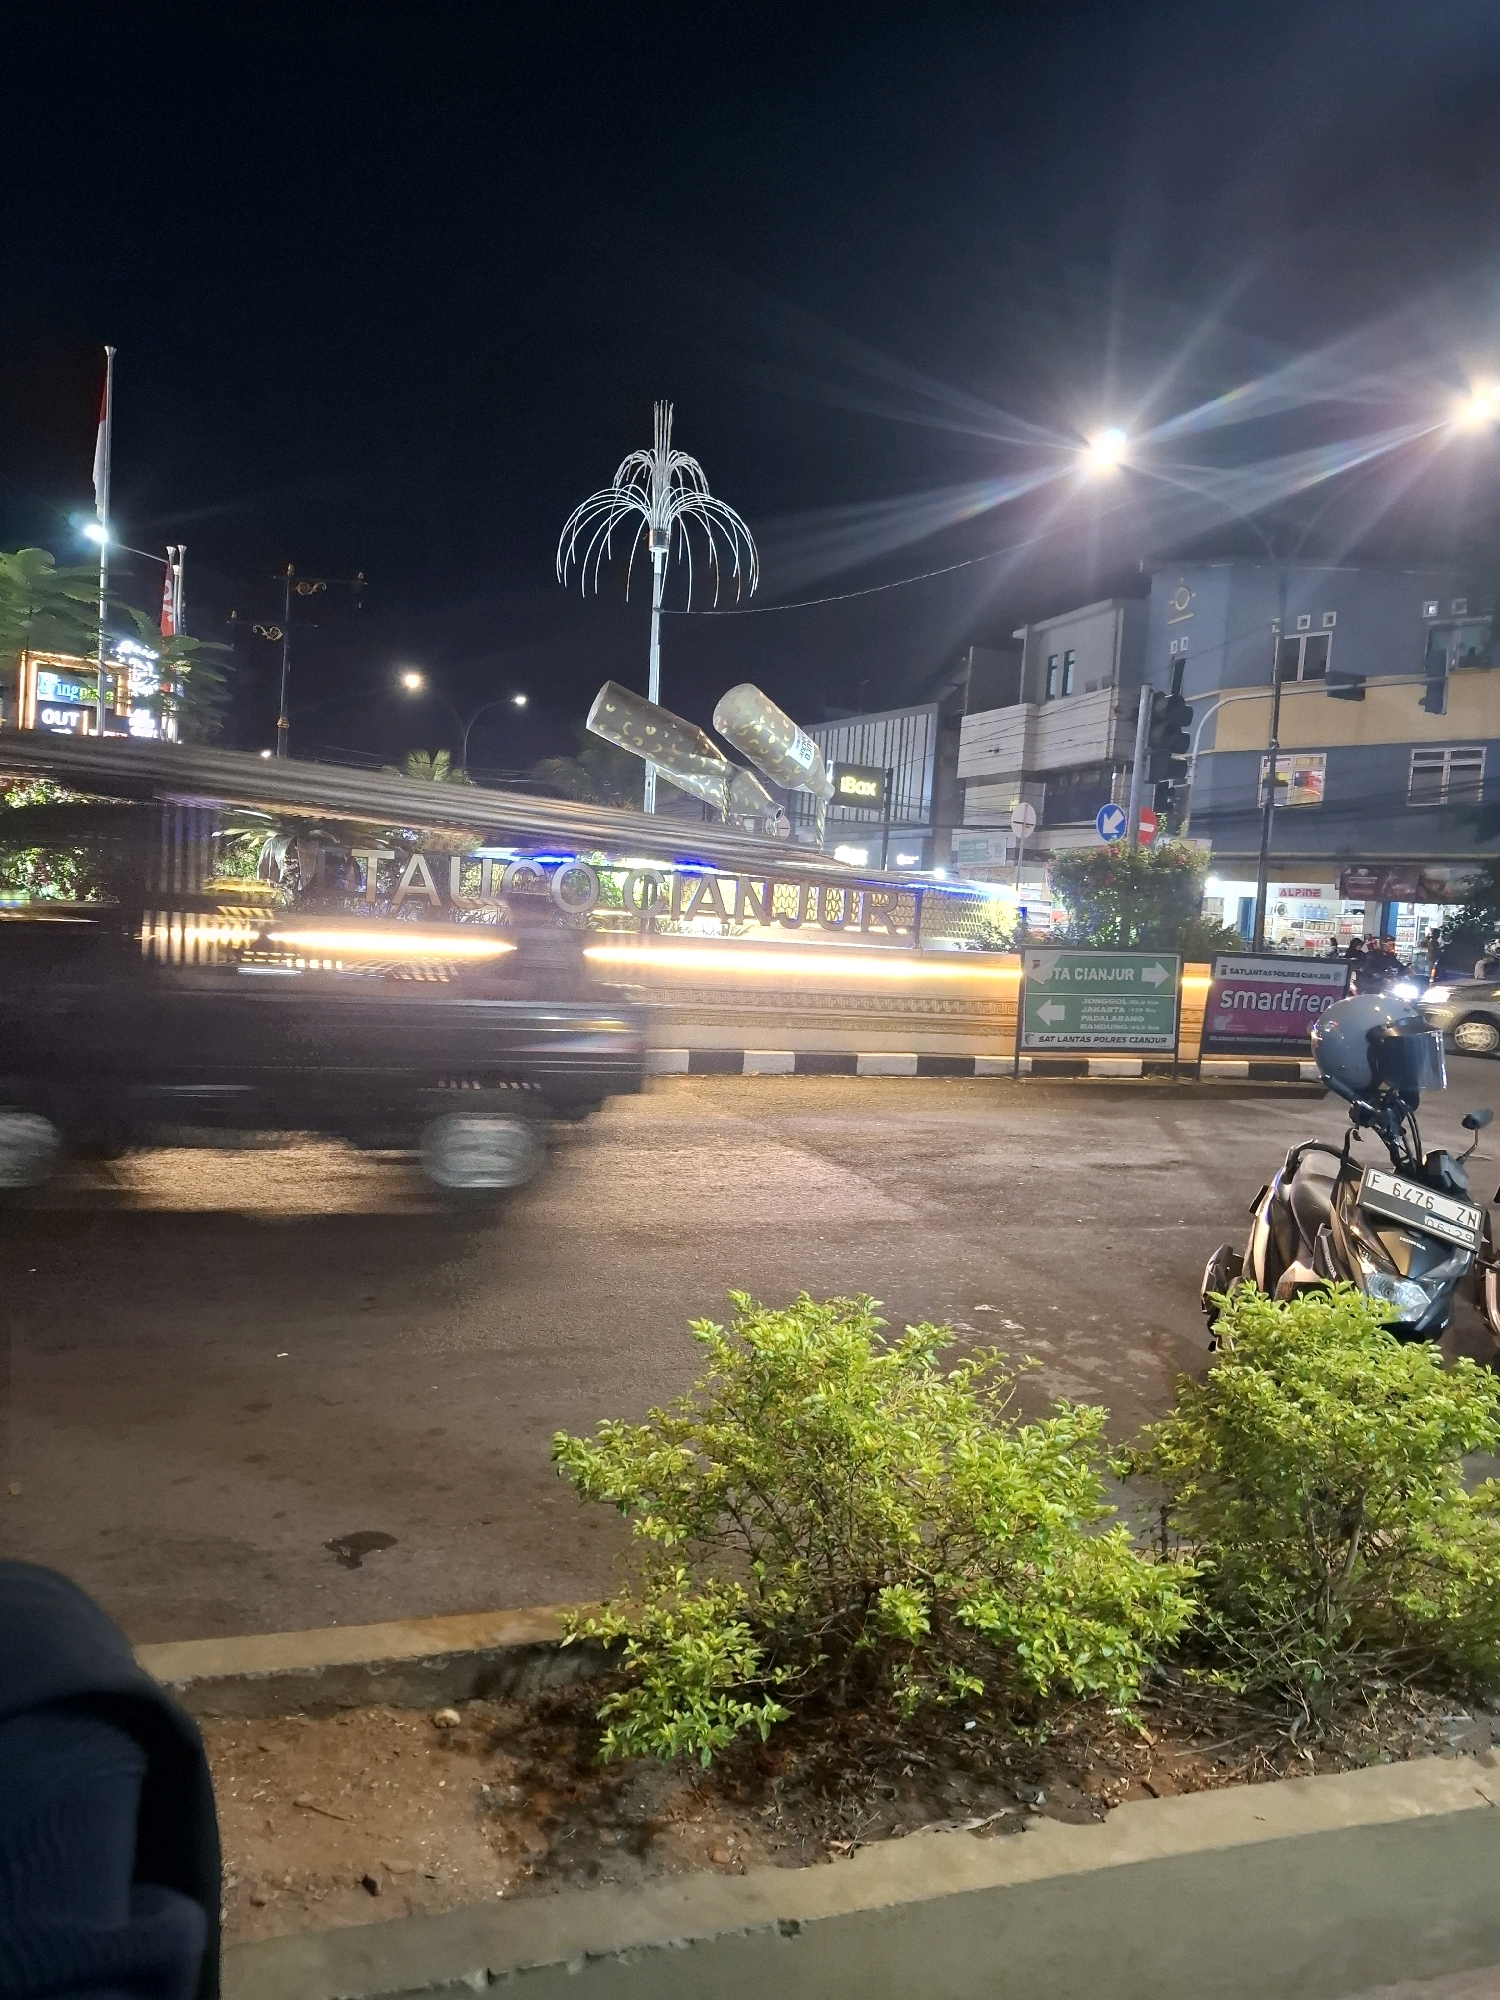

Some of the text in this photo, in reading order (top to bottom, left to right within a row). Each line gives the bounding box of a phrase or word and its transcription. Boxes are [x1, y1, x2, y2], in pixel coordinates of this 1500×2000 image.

[42, 709, 80, 727] OUT
[840, 776, 877, 797] iBox
[351, 849, 900, 935] TAUCO CIANJUR
[1074, 967, 1135, 981] CIANJUR
[1220, 987, 1335, 1013] smartfren
[1038, 1035, 1055, 1043] SAT
[1371, 1174, 1478, 1228] F 6476 ZN
[1399, 1236, 1426, 1251] HONDA
